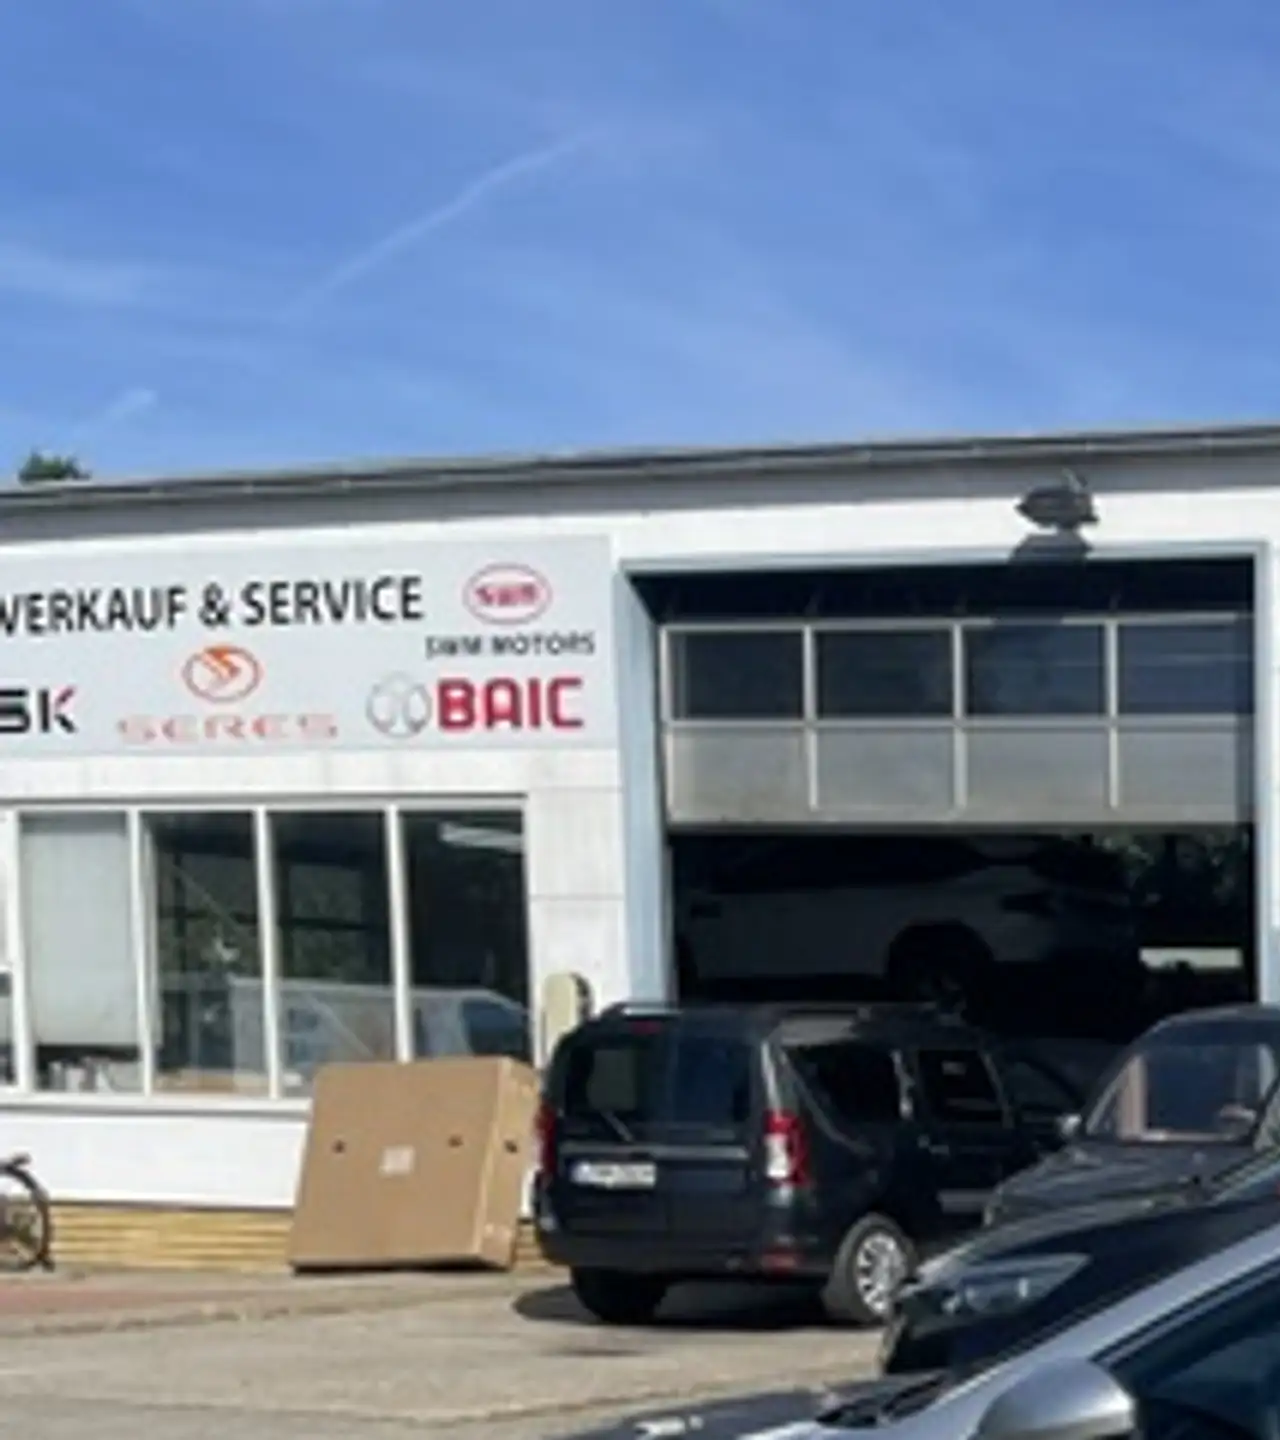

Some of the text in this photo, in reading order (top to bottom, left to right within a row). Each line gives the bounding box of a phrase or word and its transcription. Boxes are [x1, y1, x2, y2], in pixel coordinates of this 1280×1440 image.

[0, 575, 424, 636] VERKAUF & SERVICE
[492, 631, 596, 656] MOTORS
[437, 676, 584, 731] BAIC
[116, 711, 339, 742] SERES
